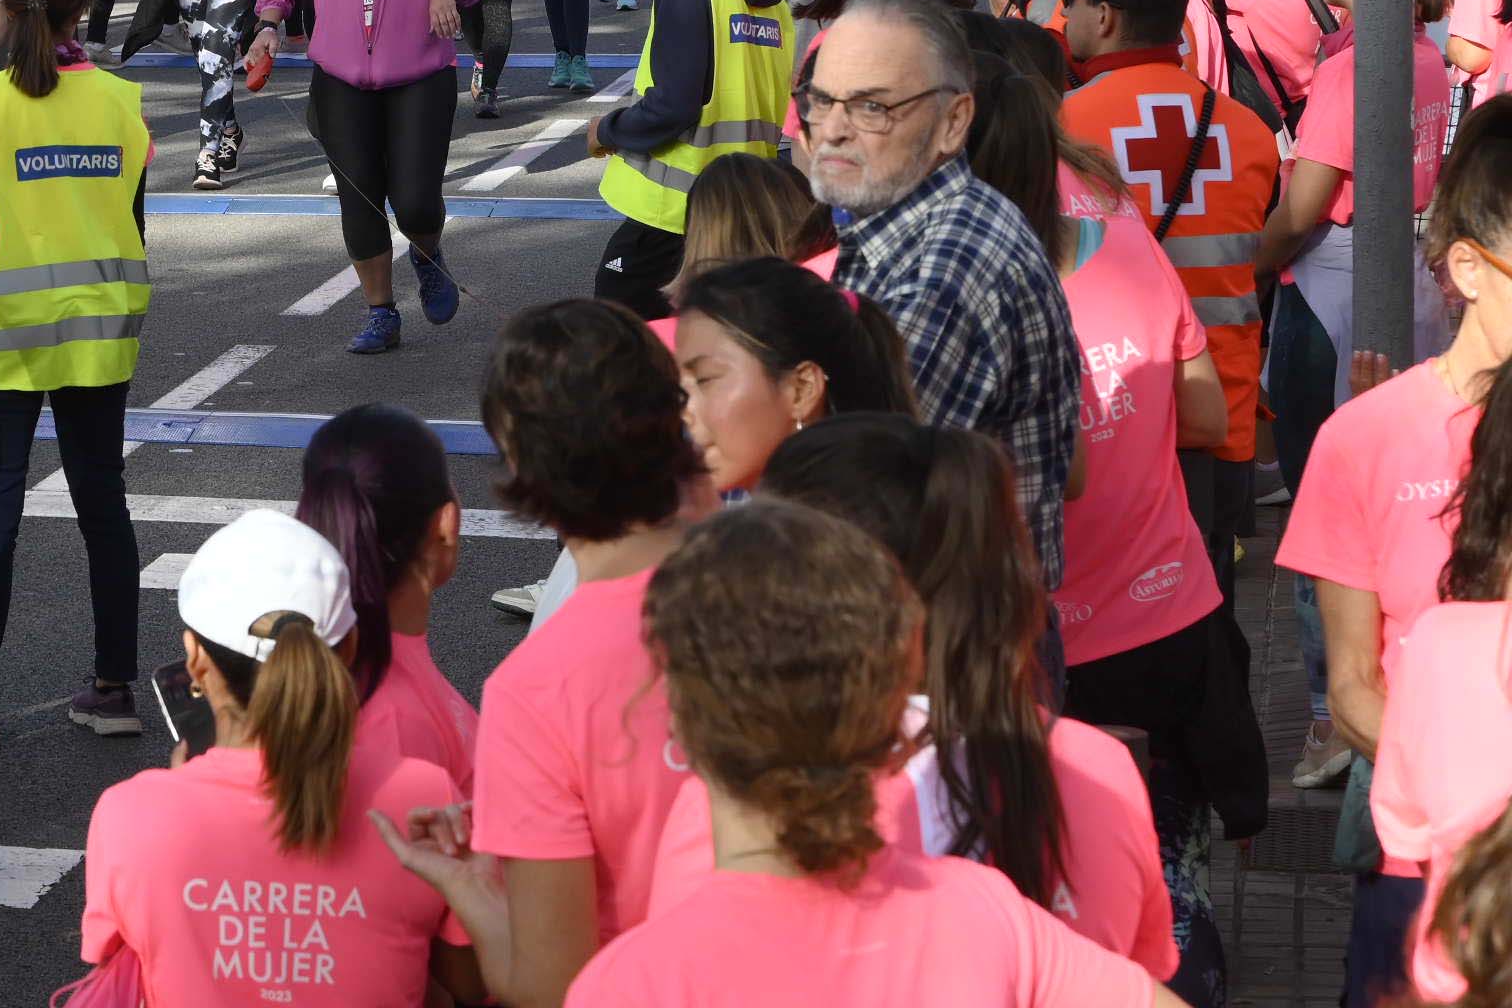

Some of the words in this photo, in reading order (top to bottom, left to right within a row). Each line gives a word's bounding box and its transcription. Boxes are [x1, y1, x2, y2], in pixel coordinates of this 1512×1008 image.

[18, 154, 118, 173] VOLUNTARIS
[183, 877, 367, 919] CARRERA
[218, 915, 266, 948] DE
[283, 918, 329, 950] LA
[213, 949, 335, 985] MUJER
[260, 988, 292, 1003] 2023
